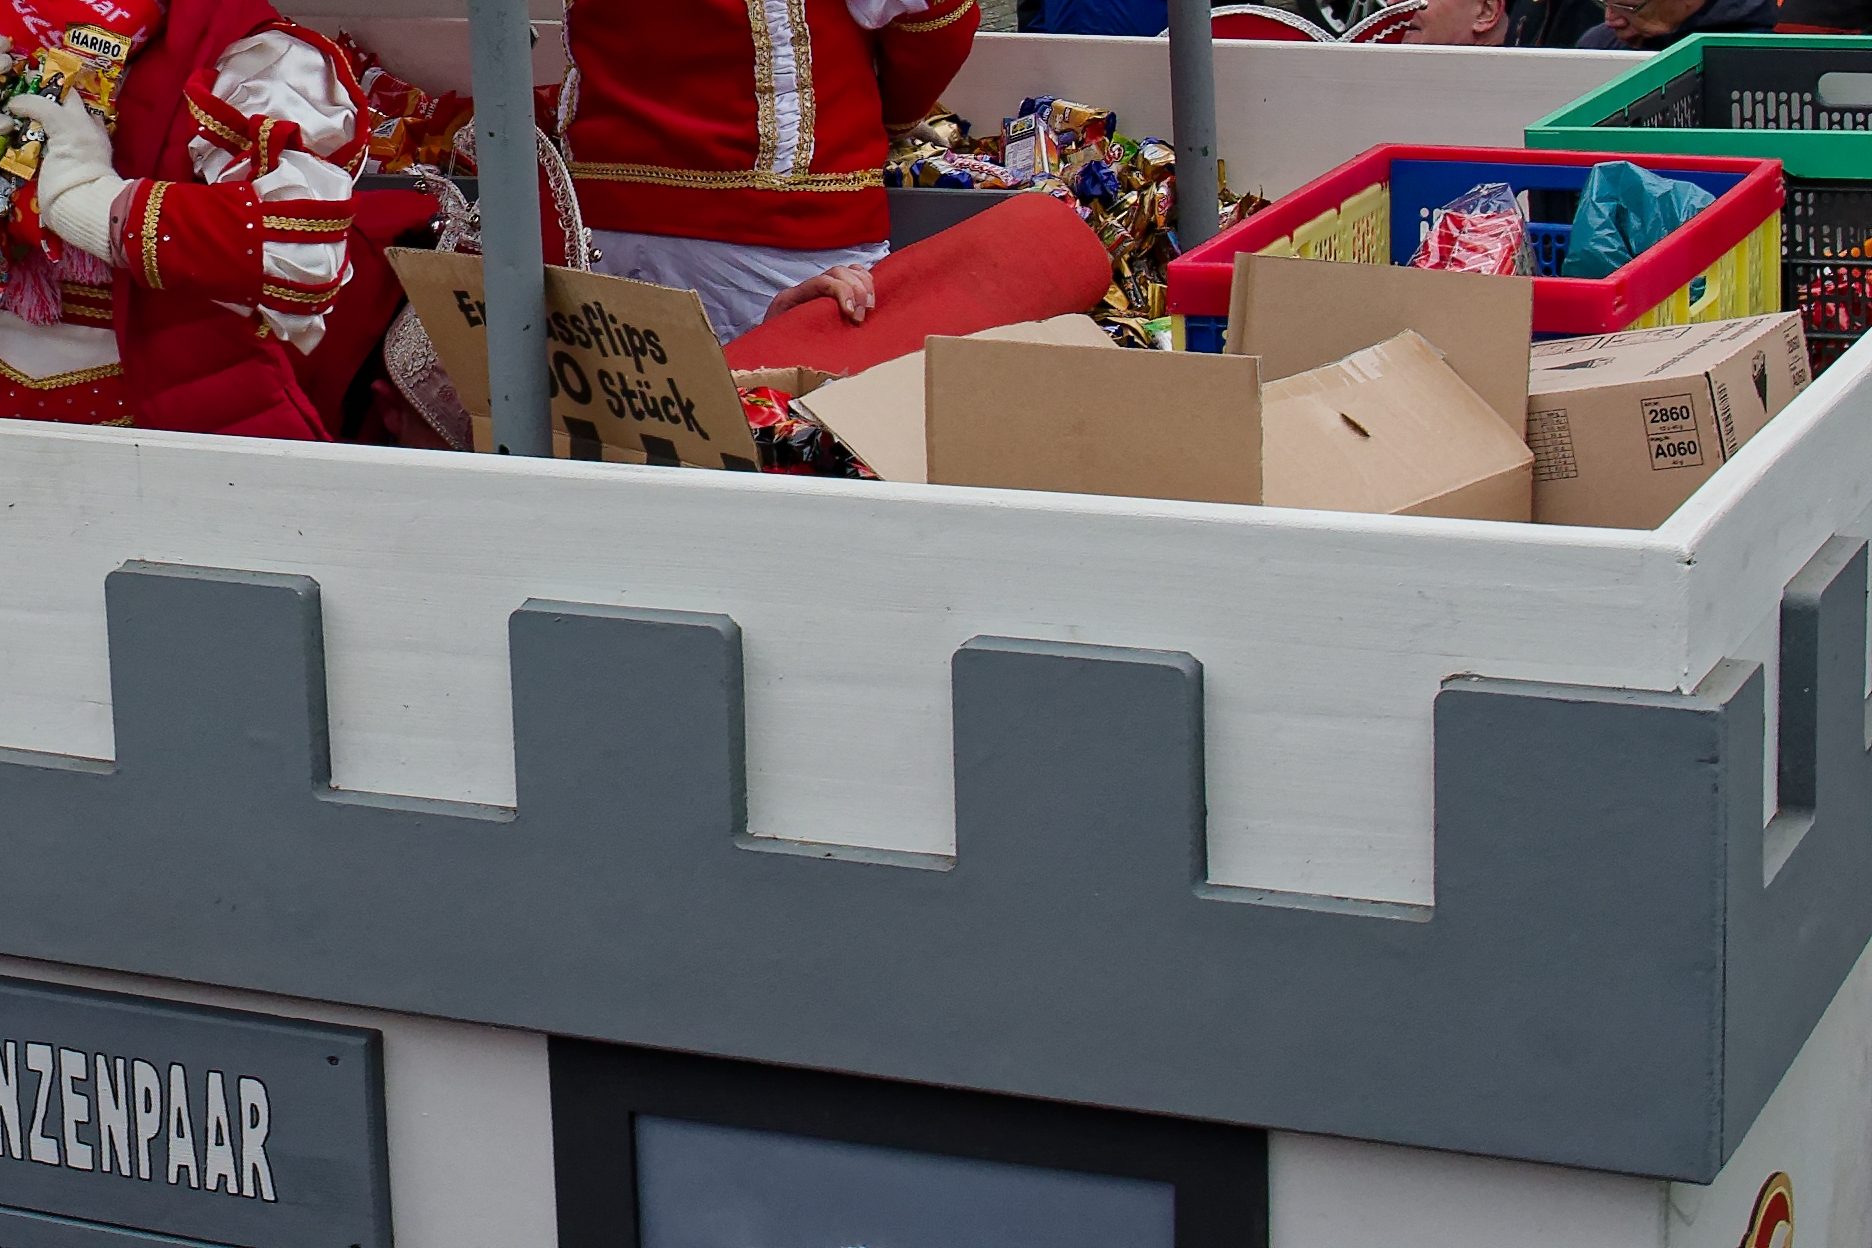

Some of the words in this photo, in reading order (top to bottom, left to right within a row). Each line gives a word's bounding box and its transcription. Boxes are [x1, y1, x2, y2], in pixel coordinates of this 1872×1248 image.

[71, 29, 121, 58] HARIBO
[598, 368, 711, 441] Stück
[1649, 405, 1690, 424] 2860
[1655, 440, 1698, 459] A060
